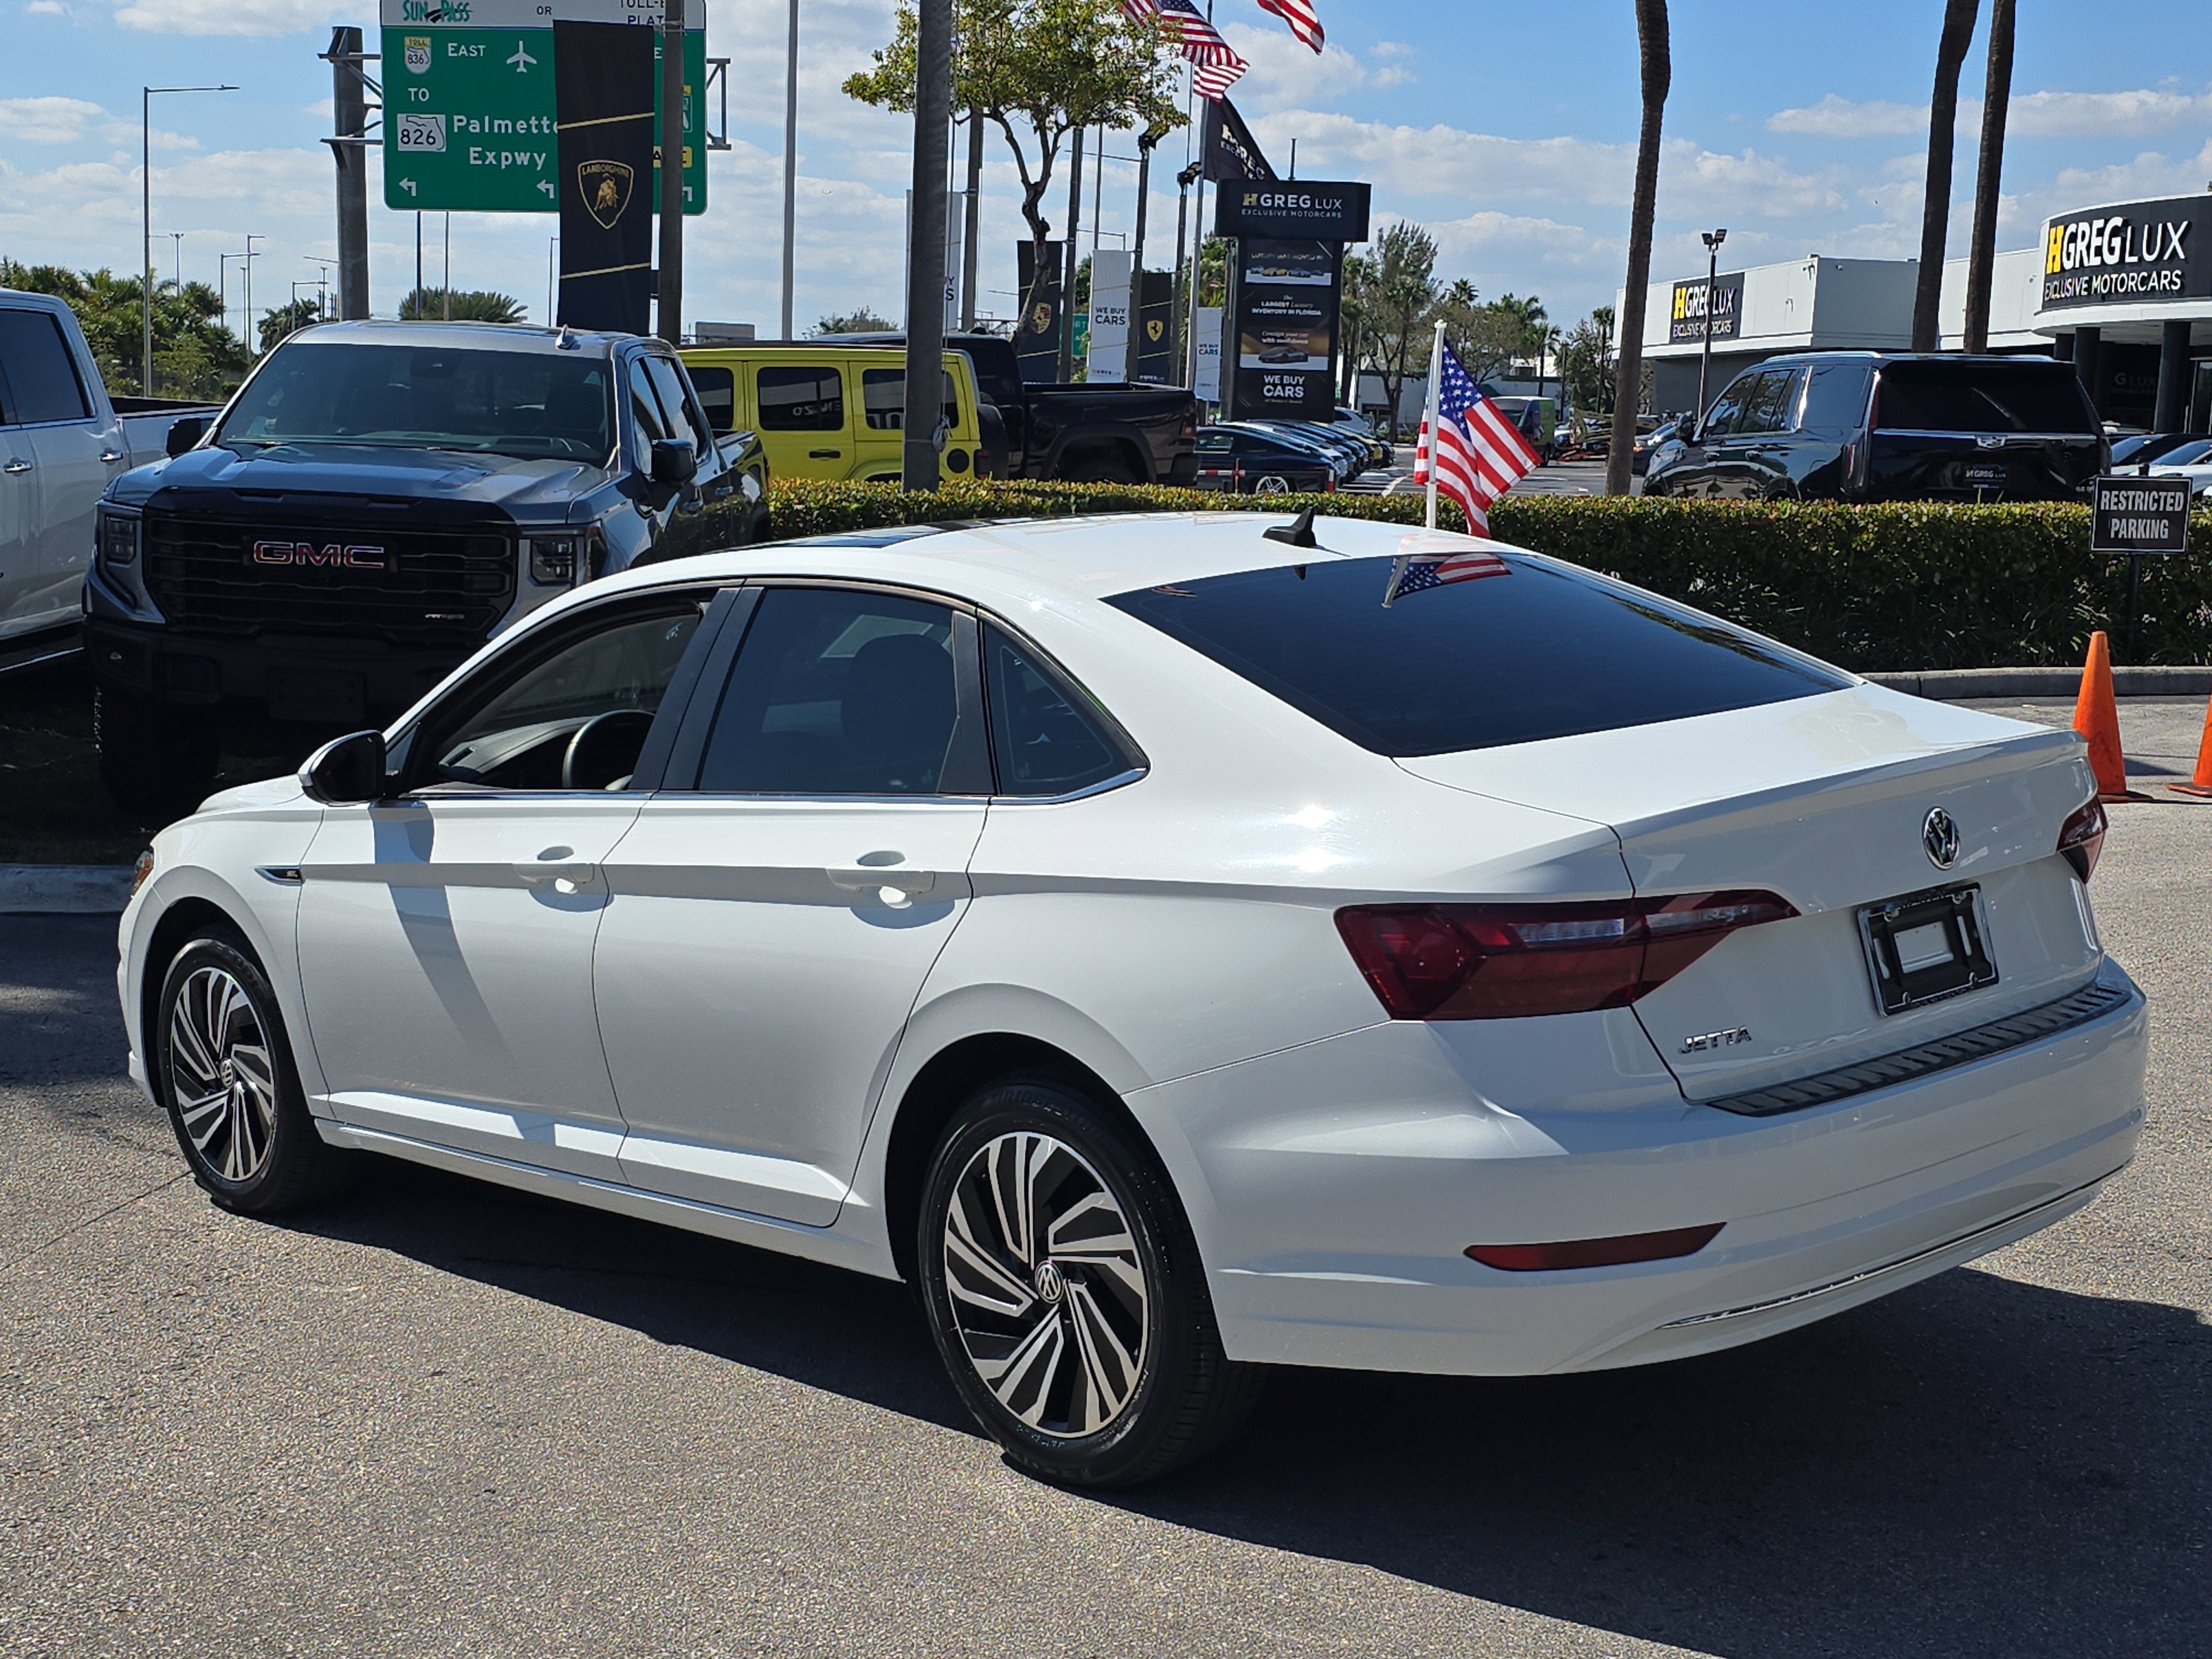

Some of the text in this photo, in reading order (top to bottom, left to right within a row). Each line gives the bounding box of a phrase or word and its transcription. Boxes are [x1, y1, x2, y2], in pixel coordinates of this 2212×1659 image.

[537, 7, 552, 15] OR
[621, 0, 664, 8] TOLL-
[628, 15, 664, 25] PLAT
[448, 43, 486, 57] EAST
[408, 54, 424, 64] 836
[408, 88, 429, 101] TO
[400, 128, 436, 145] 826
[470, 147, 546, 171] Expwy
[1243, 194, 1342, 209] HGREG LUX
[2046, 217, 2189, 274] HGREG LUX
[2091, 269, 2182, 295] MOTORCARS
[1713, 287, 1735, 314] LUX
[1095, 314, 1126, 325] CARS
[1264, 375, 1304, 384] WE BUY
[1263, 385, 1304, 397] CARS
[2100, 490, 2184, 512] RESTRICTED
[2110, 518, 2169, 539] PARKING
[254, 541, 384, 569] GMC
[1679, 1025, 1752, 1054] JETTA
